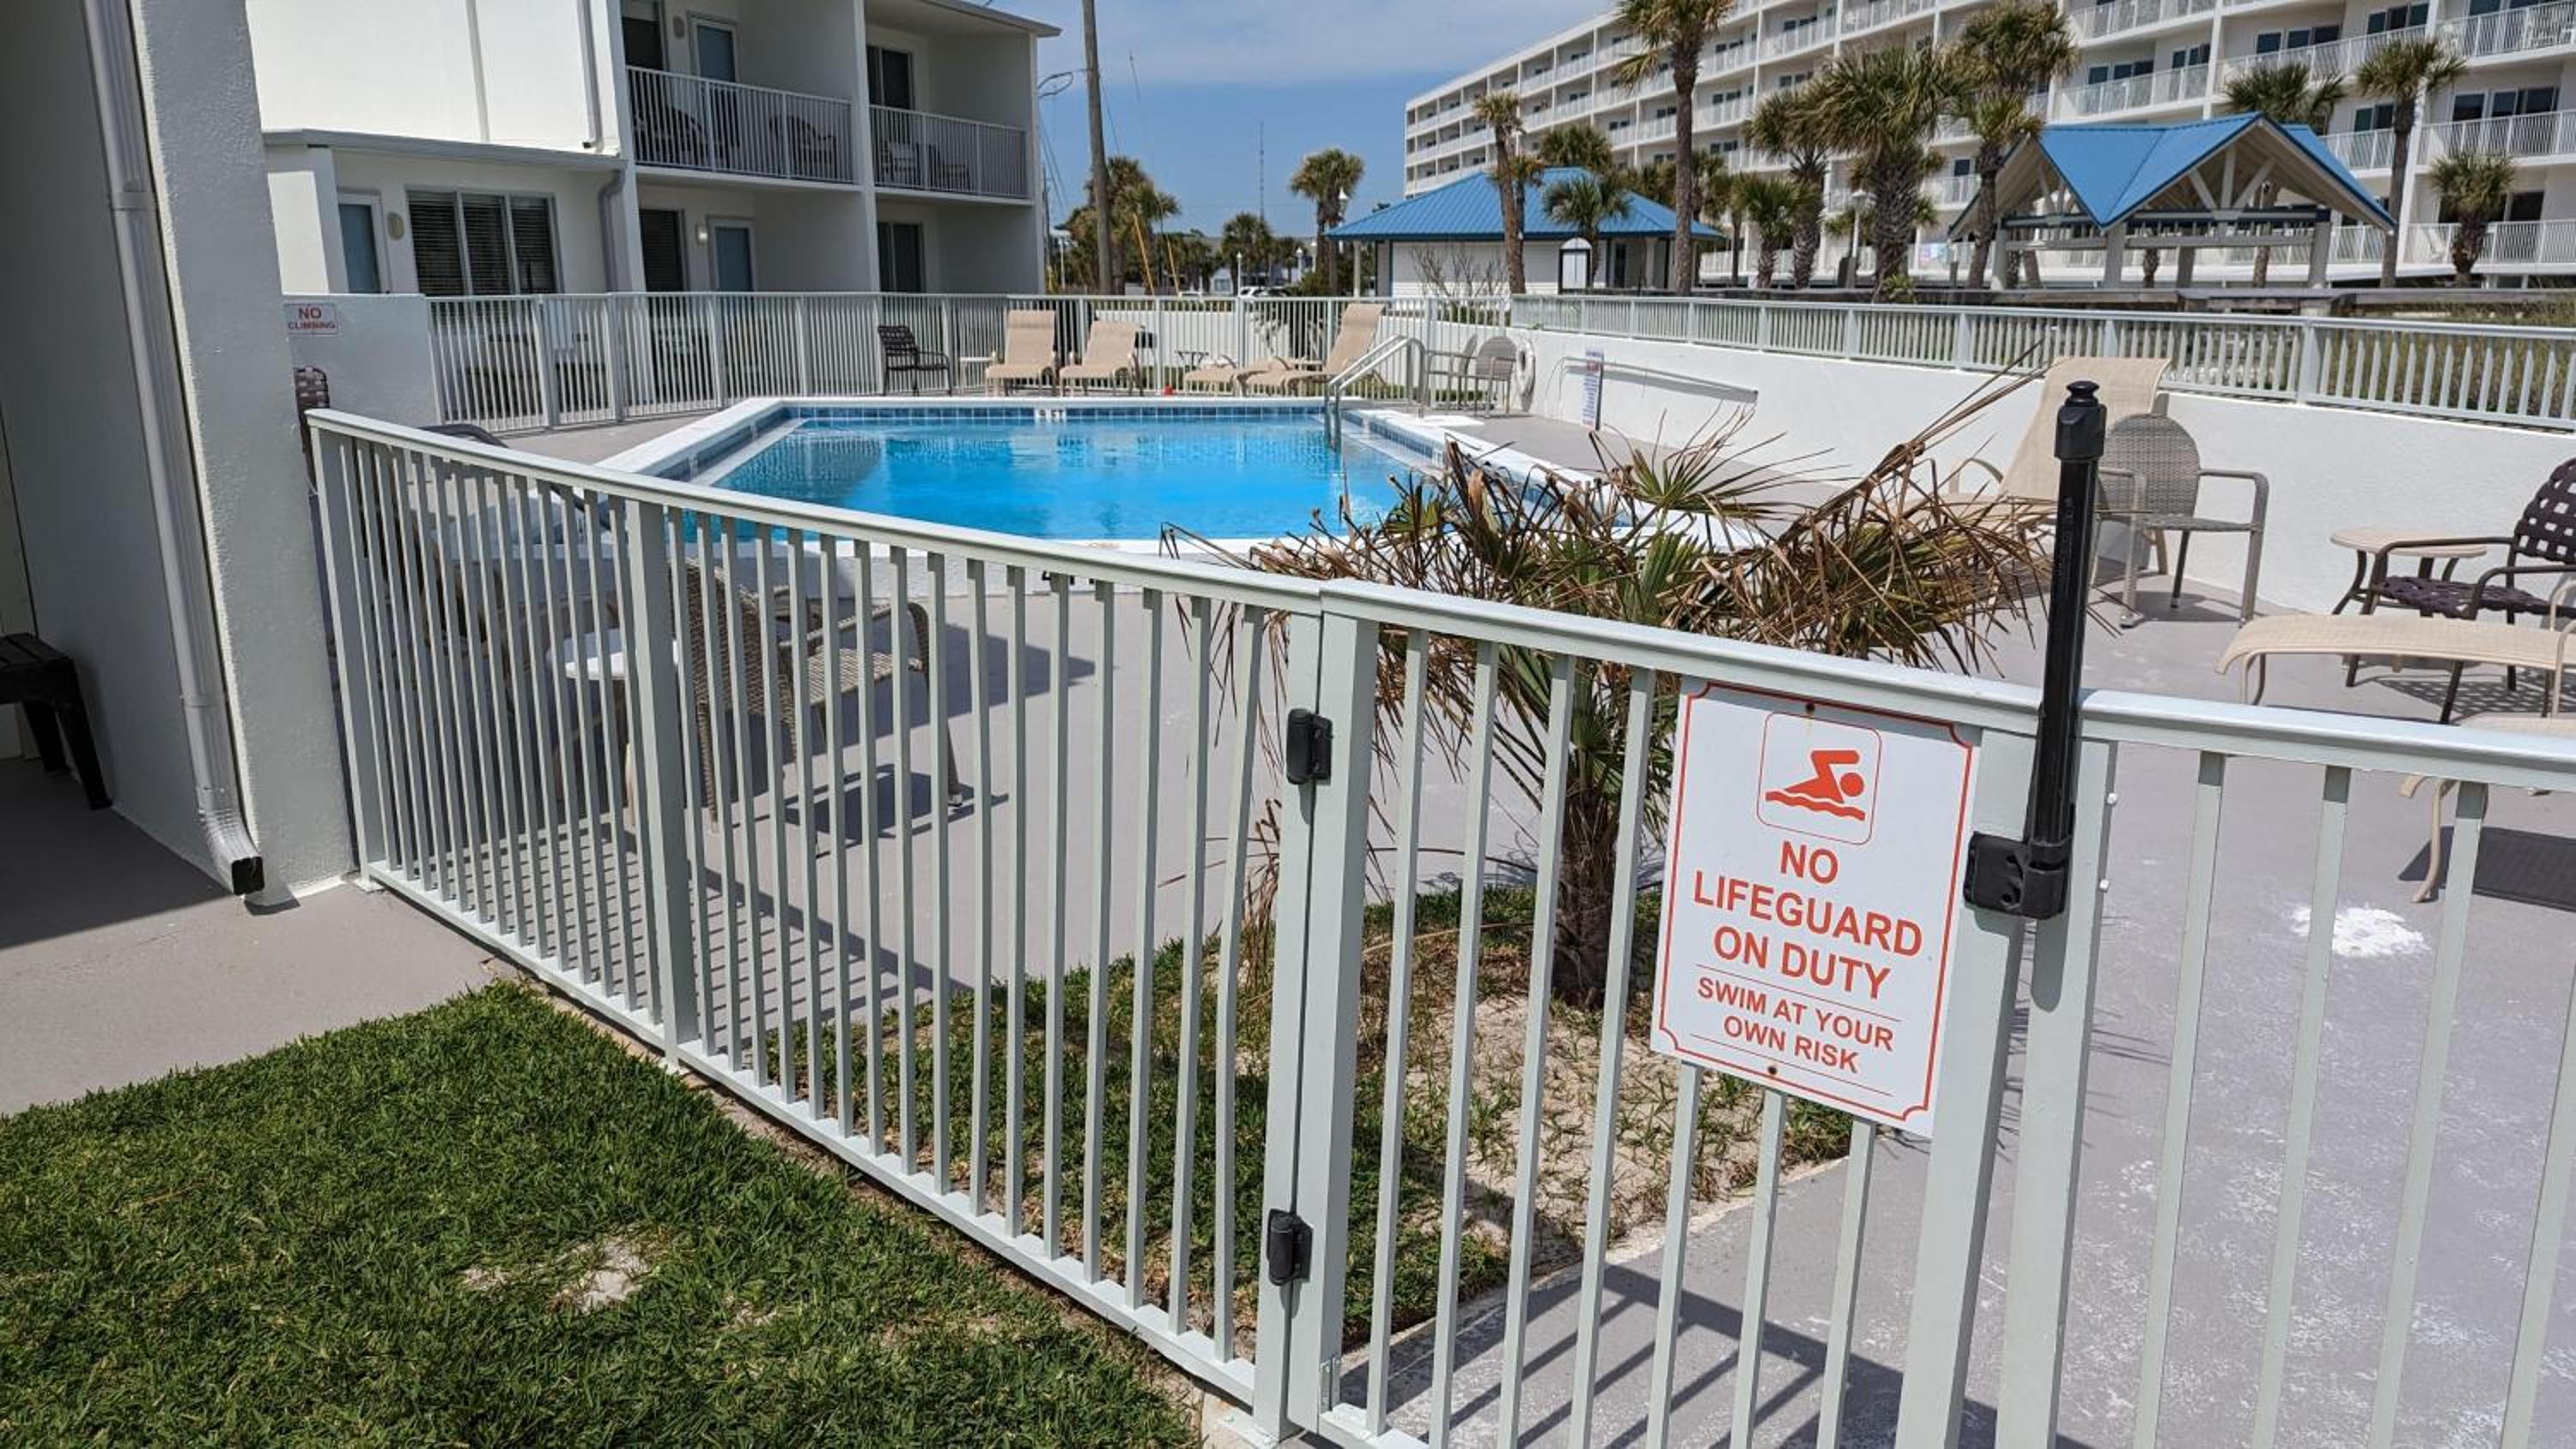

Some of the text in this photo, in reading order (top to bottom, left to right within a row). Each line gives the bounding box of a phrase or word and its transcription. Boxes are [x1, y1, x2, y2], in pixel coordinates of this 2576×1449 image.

[298, 306, 322, 318] NO
[1779, 841, 1839, 884] NO
[1693, 870, 1923, 957] LIFEGUARD
[1713, 925, 1890, 1000] ON DUTY
[1698, 978, 1894, 1052] SWIM AT YOUR
[1724, 1016, 1859, 1074] OWN RISK
